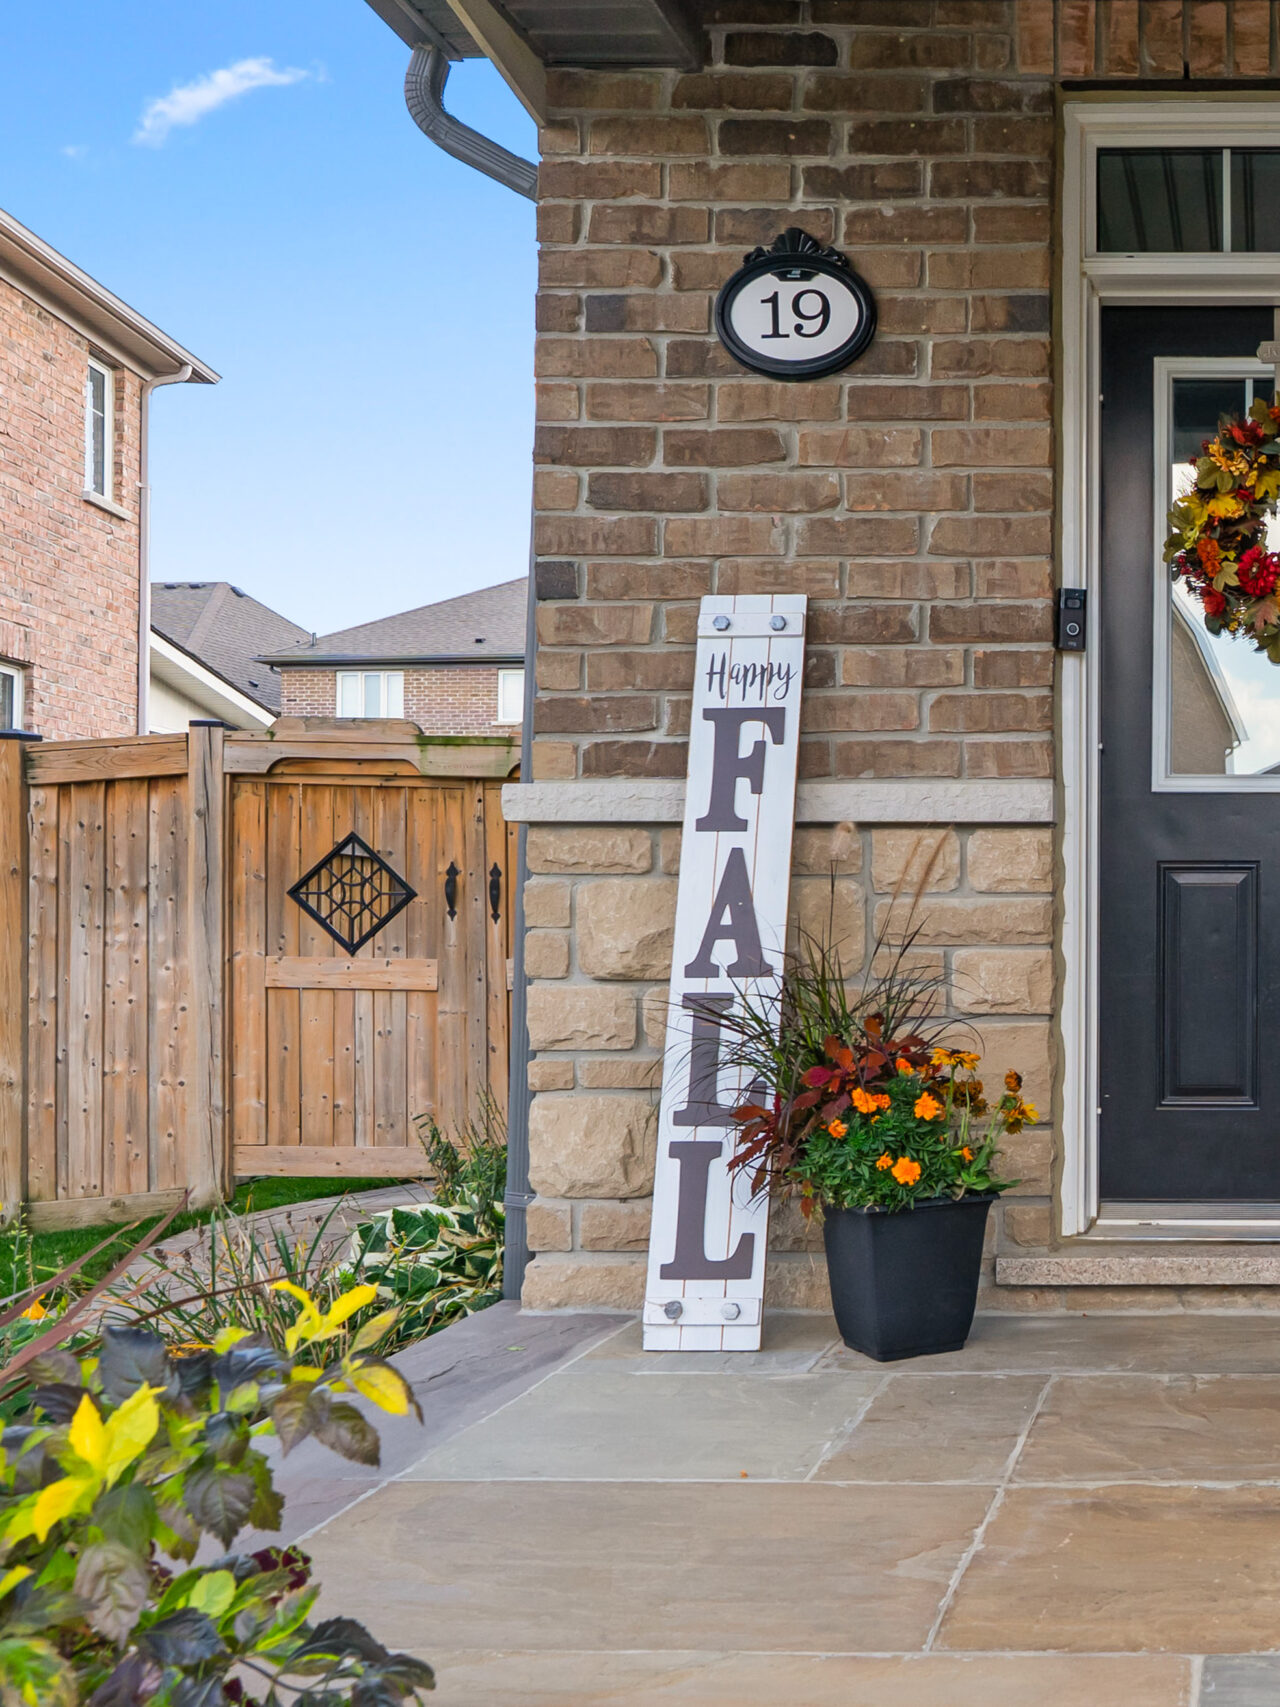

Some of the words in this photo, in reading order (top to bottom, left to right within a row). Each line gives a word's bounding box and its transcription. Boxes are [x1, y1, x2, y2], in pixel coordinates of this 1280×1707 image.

[760, 289, 831, 339] 19
[706, 652, 798, 701] Happy
[660, 707, 786, 1280] FALL
